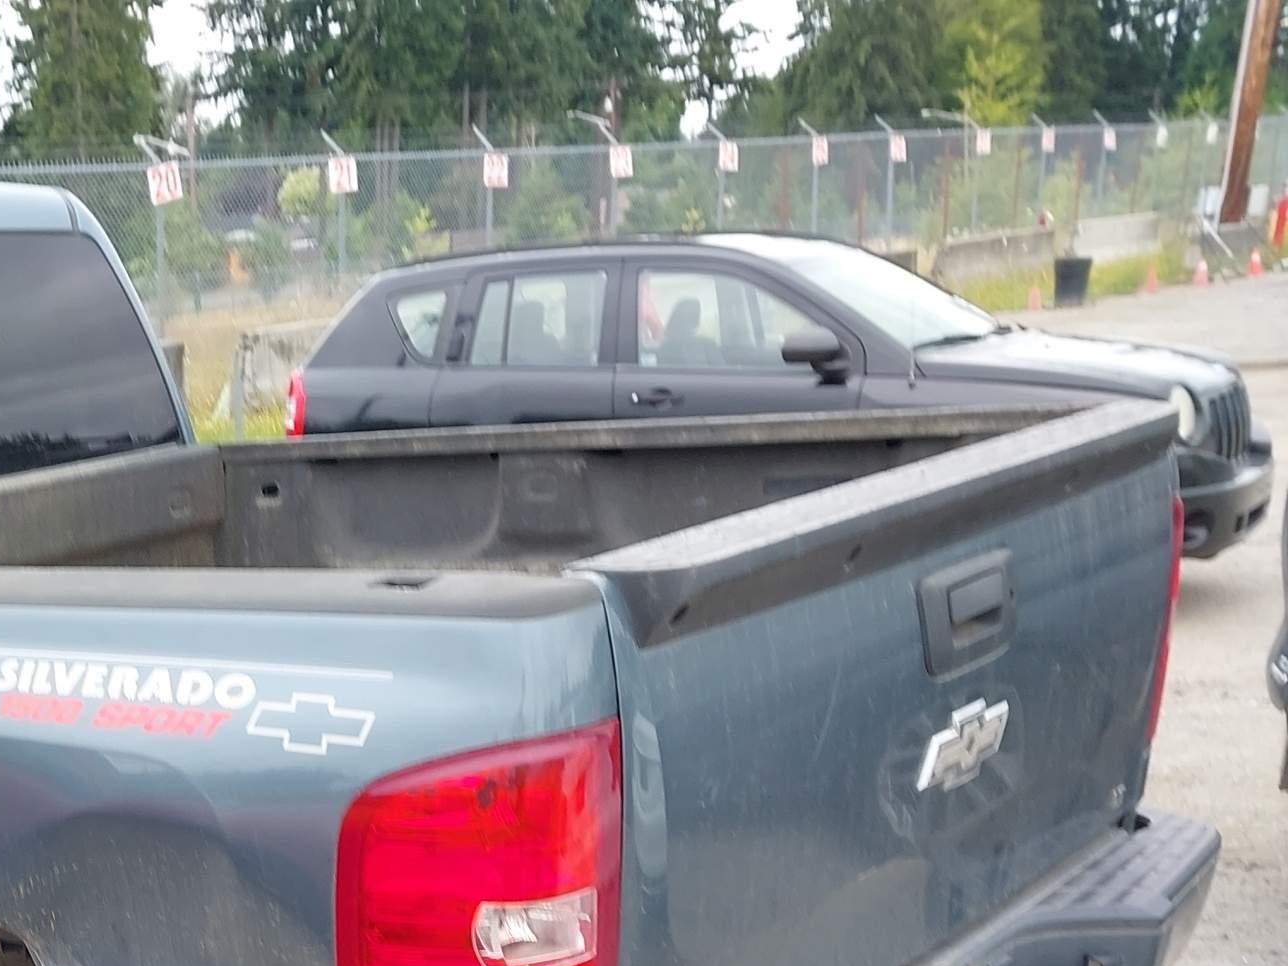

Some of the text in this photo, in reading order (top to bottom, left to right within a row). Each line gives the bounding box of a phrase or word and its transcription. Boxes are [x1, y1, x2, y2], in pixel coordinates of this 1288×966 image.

[152, 164, 179, 202] 20
[332, 157, 353, 192] 21
[92, 702, 233, 738] SPORT
